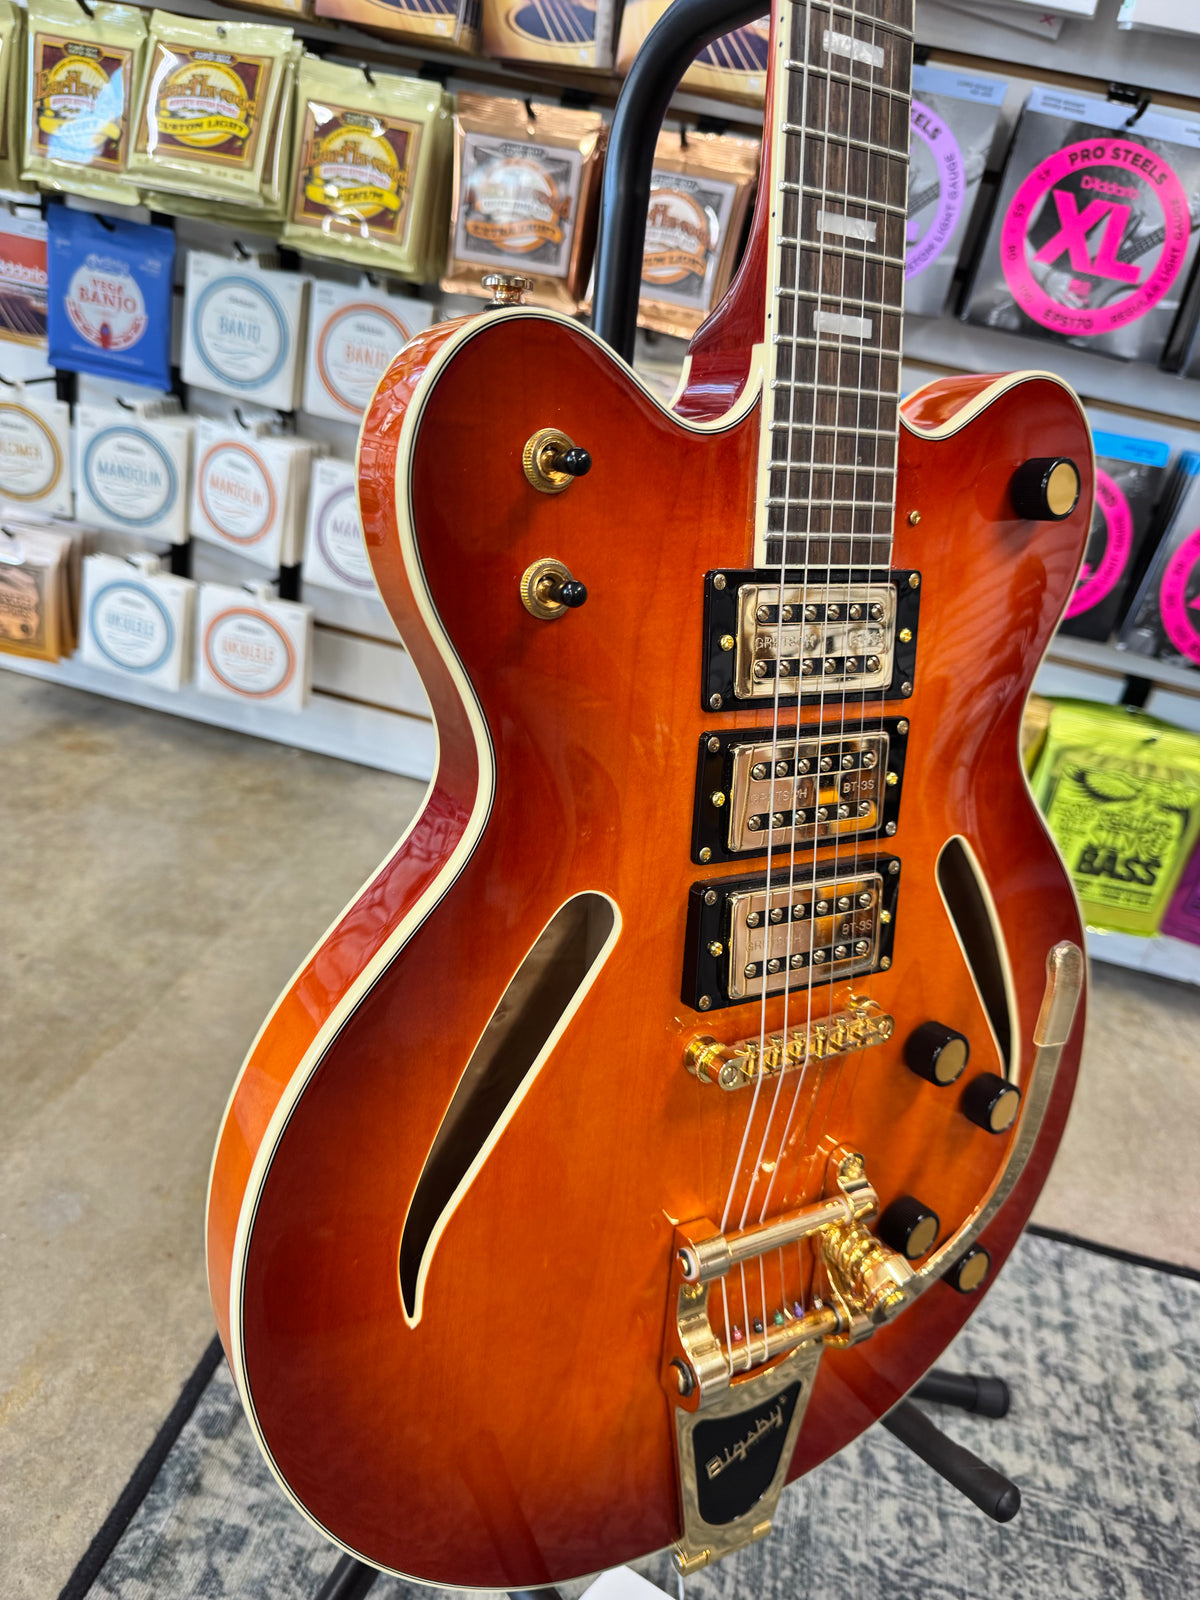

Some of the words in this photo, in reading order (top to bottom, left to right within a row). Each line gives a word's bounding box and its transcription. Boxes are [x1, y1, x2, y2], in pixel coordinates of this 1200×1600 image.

[157, 73, 256, 116] arthwood
[1068, 146, 1105, 166] PRO
[1111, 147, 1168, 185] STEELS
[1032, 189, 1142, 285] XL
[78, 286, 137, 314] BANJO
[219, 316, 261, 344] BANJO
[97, 460, 162, 487] MANDOLIN
[755, 635, 816, 650] GRETSH
[1074, 842, 1162, 886] BASS
[705, 1404, 783, 1480] Bigsby
